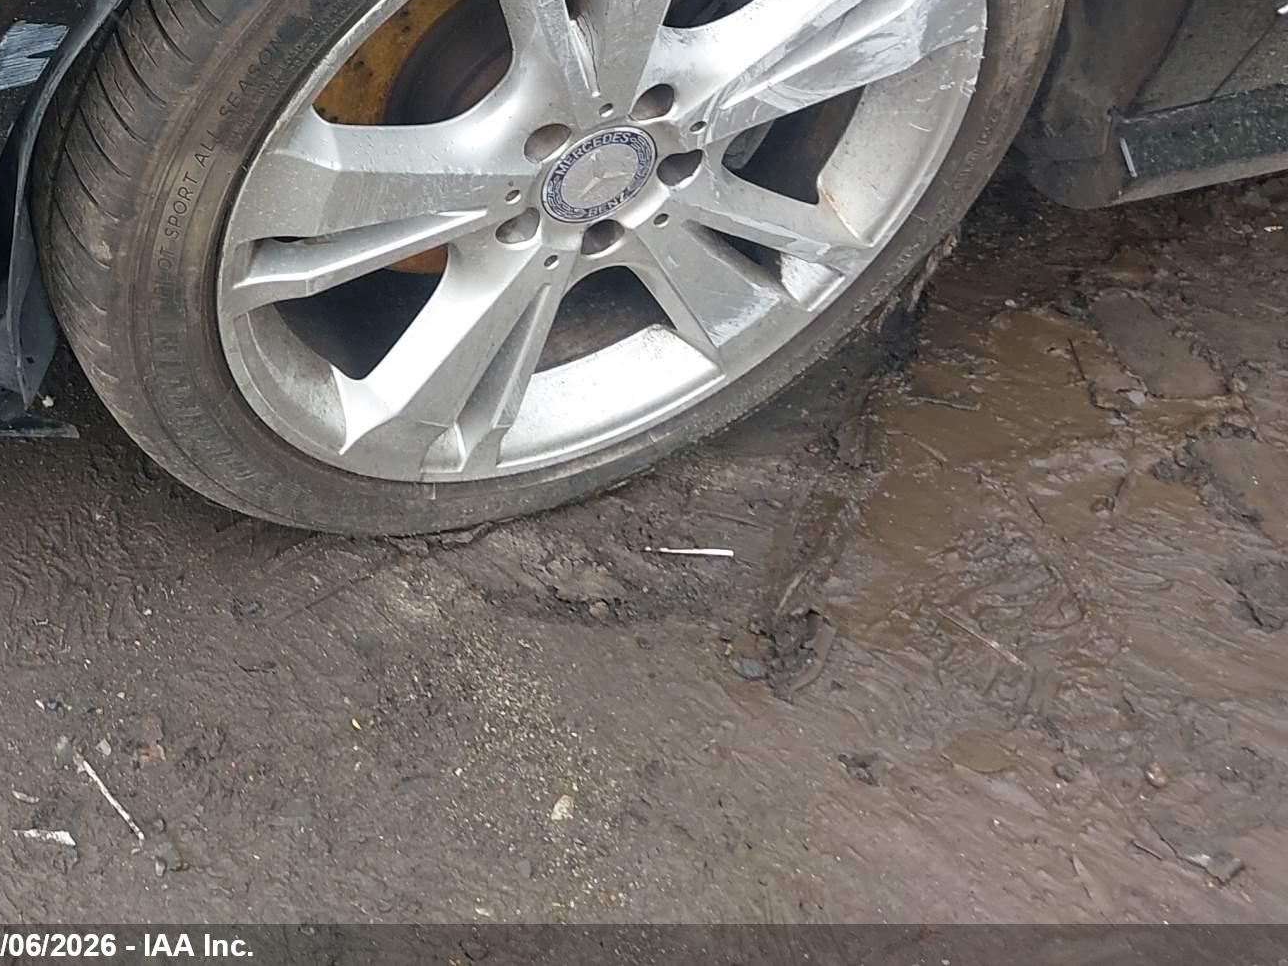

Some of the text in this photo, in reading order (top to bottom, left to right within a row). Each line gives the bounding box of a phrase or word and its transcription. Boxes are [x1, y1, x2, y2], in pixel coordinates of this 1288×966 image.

[164, 174, 201, 240] SPORT
[196, 129, 222, 168] ALL
[219, 36, 284, 117] SEASON
[555, 131, 632, 176] MERCEDES
